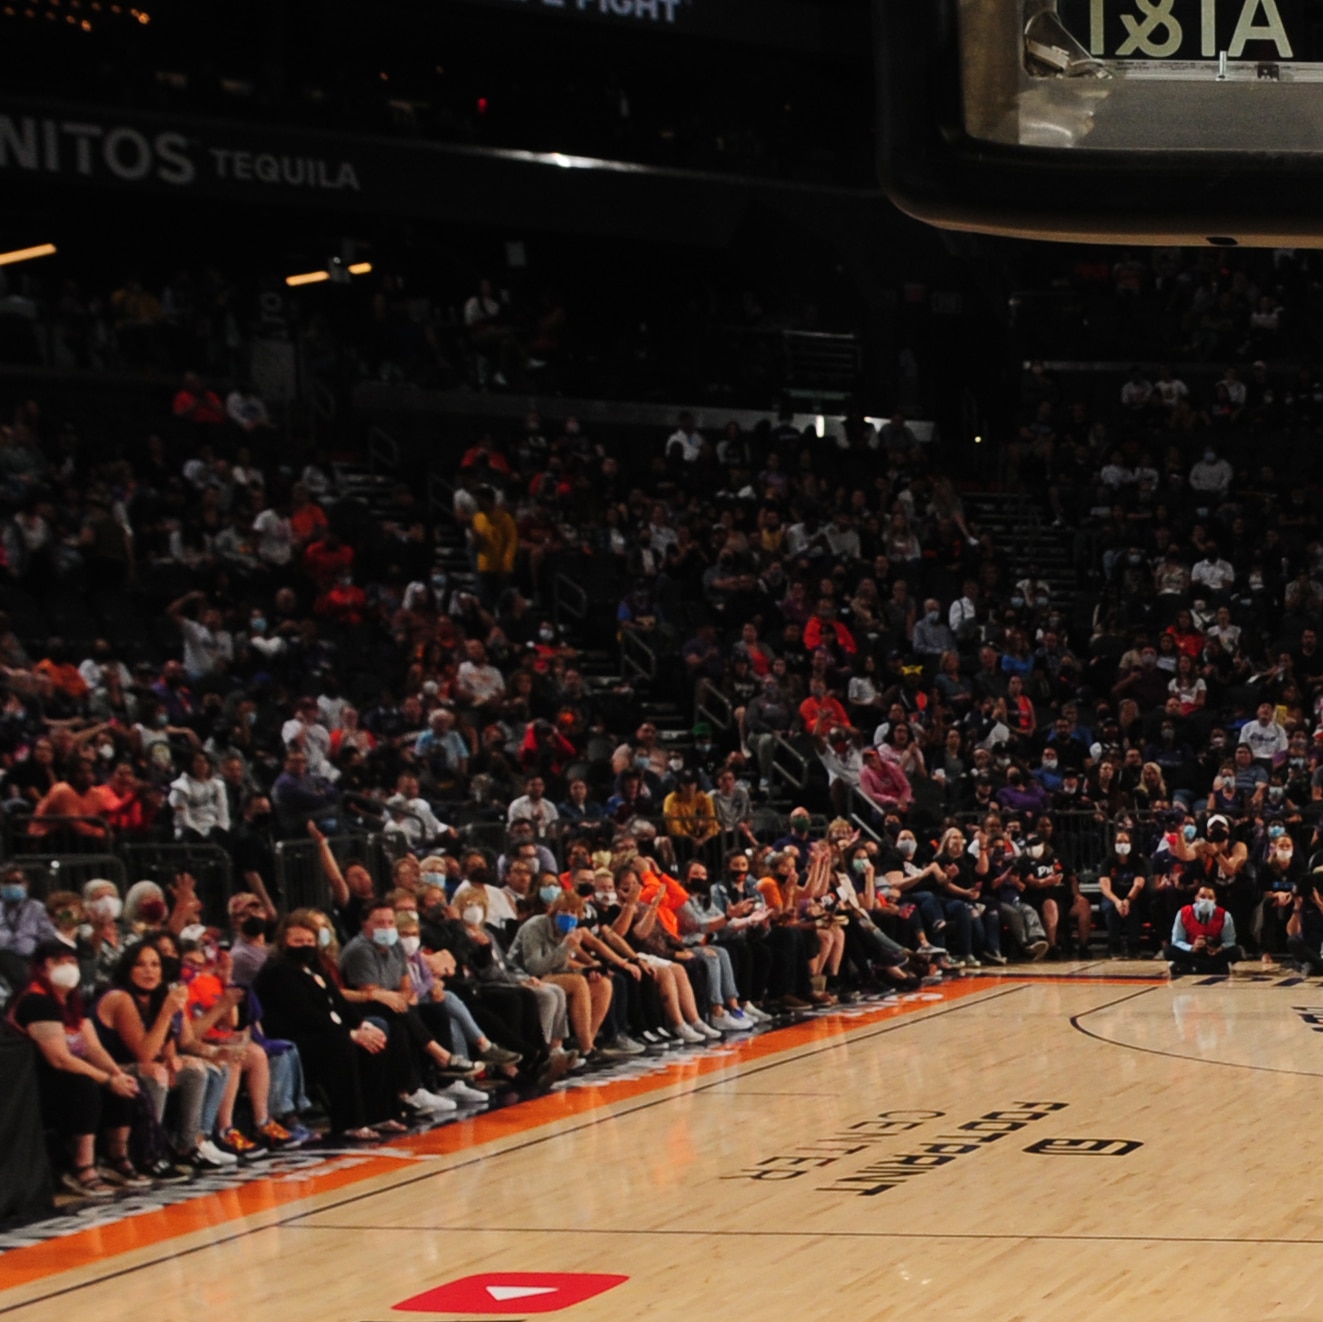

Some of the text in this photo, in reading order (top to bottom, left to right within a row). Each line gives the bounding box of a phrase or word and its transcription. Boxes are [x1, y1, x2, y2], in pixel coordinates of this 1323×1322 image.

[208, 146, 361, 193] TEQUILA
[719, 1109, 946, 1181] CENTER
[815, 1101, 1070, 1197] FOOTPRINT
